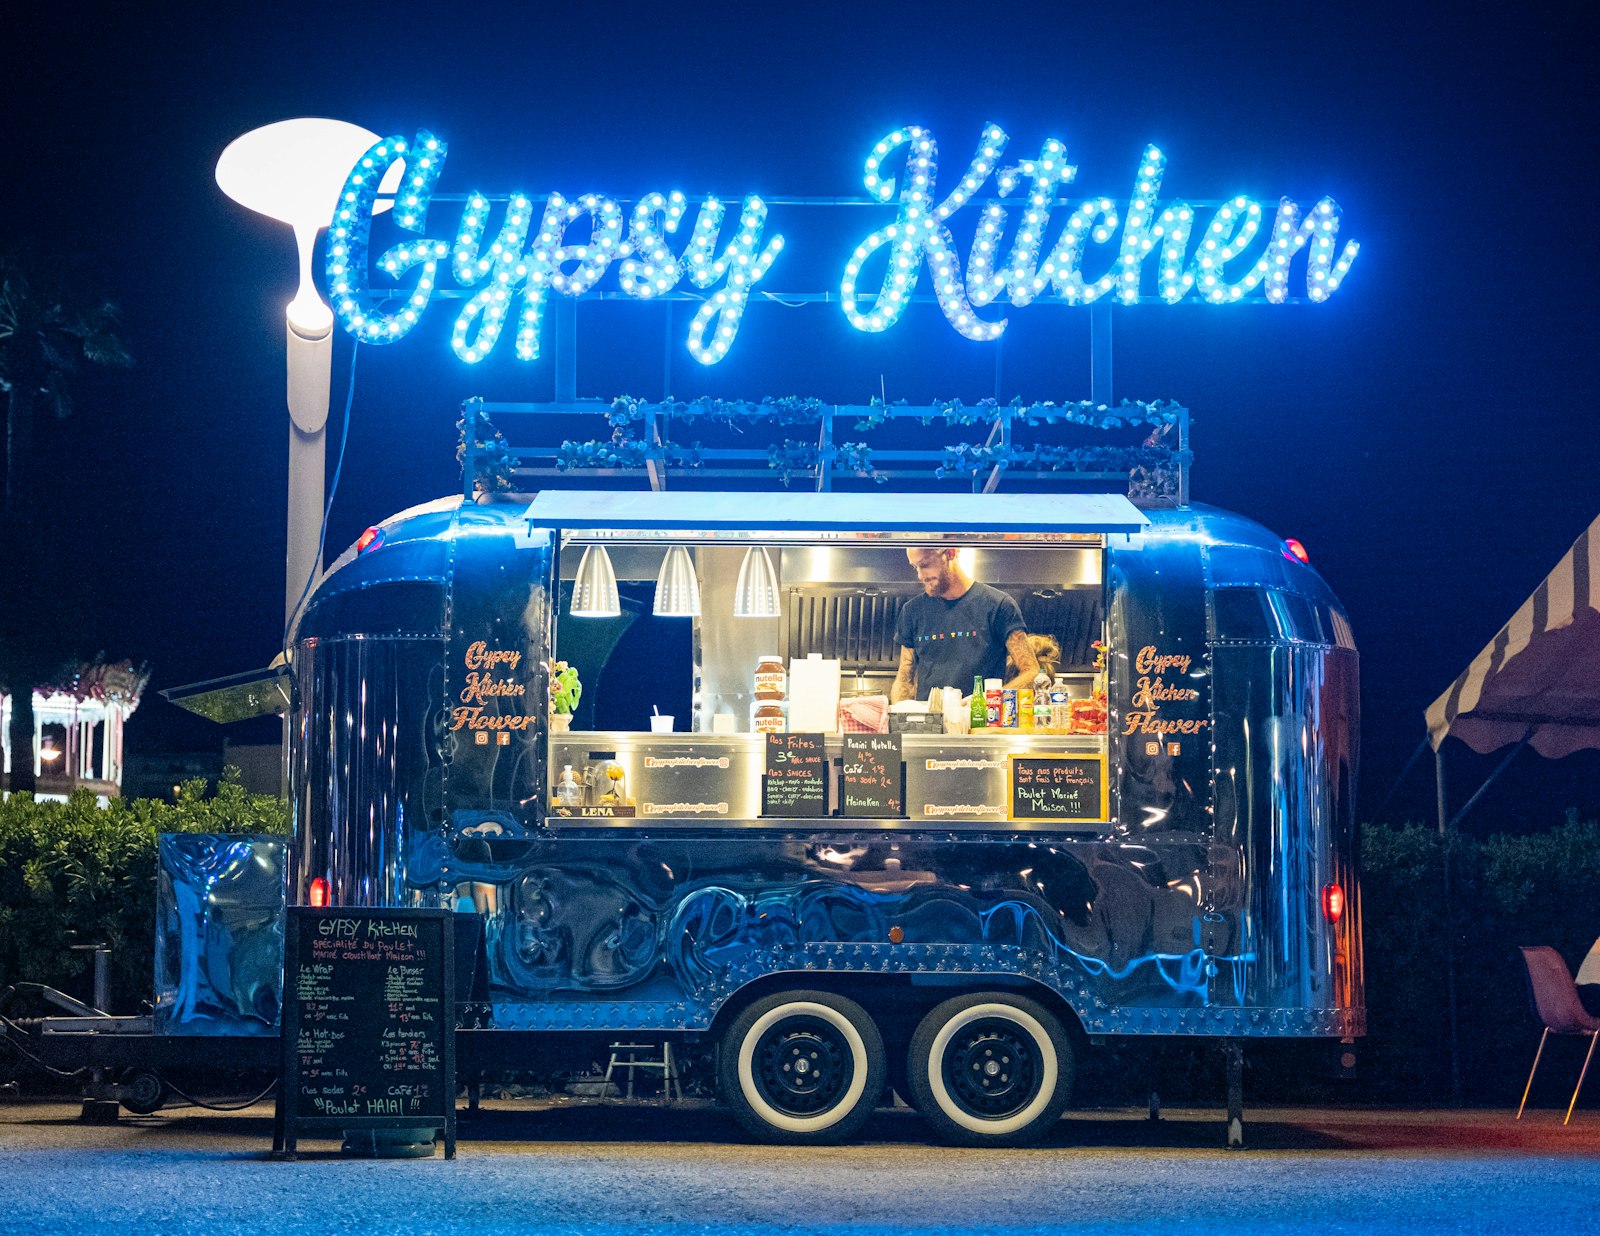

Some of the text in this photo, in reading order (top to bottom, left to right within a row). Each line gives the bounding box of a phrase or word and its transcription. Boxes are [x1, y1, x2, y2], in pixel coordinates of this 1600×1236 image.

[326, 121, 1360, 365] Gypsy Kitchen
[464, 641, 521, 670] Gypsy
[1135, 645, 1192, 675] Gypsy
[755, 674, 783, 682] nutella
[460, 672, 525, 706] Kitchen
[1131, 676, 1198, 710] Kitchen
[449, 706, 537, 731] Flower
[755, 718, 783, 726] nutella
[1121, 711, 1208, 736] Flower
[847, 738, 898, 751] Panini Nutella
[1053, 766, 1084, 777] produits
[1018, 787, 1046, 799] Poulet
[581, 807, 615, 816] LENA
[1032, 799, 1068, 812] Maison
[318, 919, 362, 940] GYPSY
